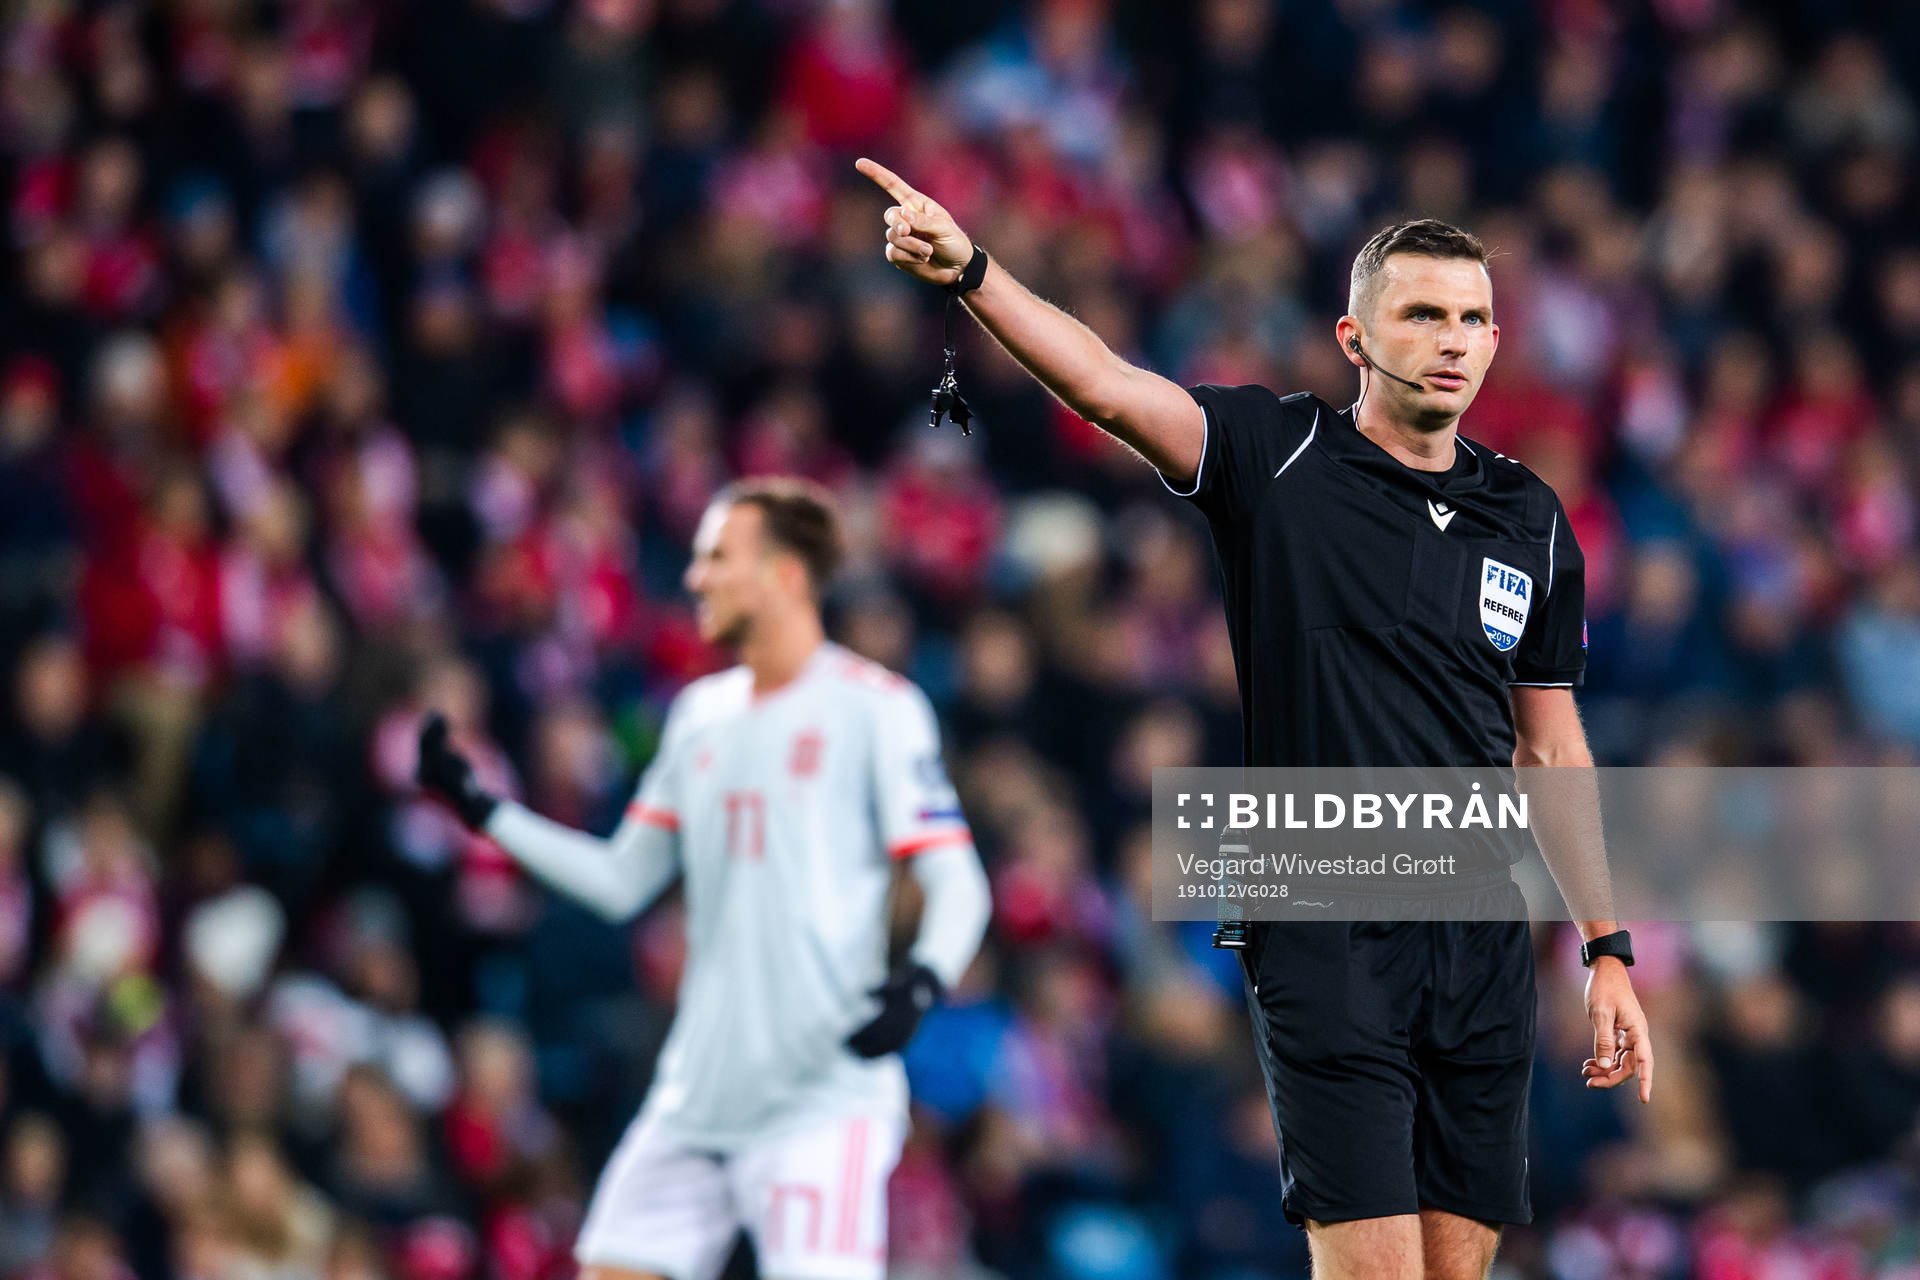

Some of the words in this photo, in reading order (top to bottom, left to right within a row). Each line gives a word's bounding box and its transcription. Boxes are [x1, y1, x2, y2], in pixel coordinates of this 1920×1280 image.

[1486, 565, 1527, 600] FIFA
[1483, 598, 1524, 624] REFEREE
[1491, 629, 1511, 645] 2019
